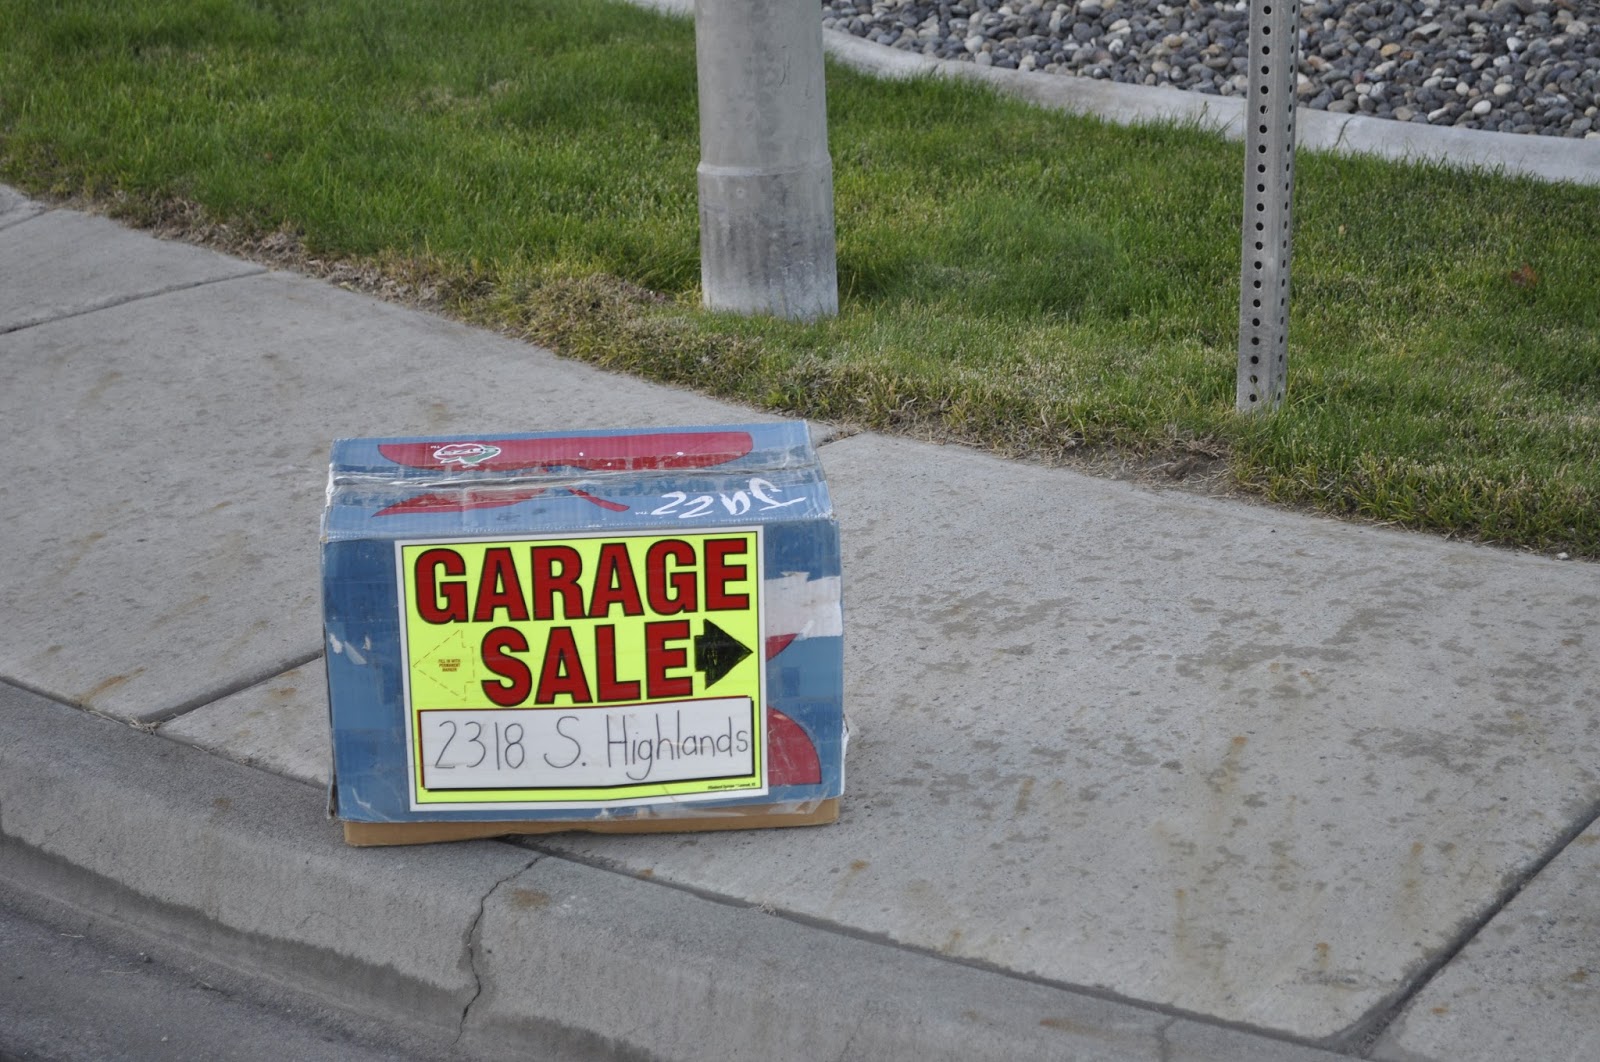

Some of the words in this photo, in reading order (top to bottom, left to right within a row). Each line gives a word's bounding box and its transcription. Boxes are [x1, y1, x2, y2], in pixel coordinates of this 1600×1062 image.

[650, 477, 807, 519] Jazz
[414, 537, 750, 625] GARAGE
[480, 619, 693, 707] SALE
[434, 719, 526, 771] 2318
[544, 716, 588, 769] S.
[605, 709, 749, 781] Highlands
